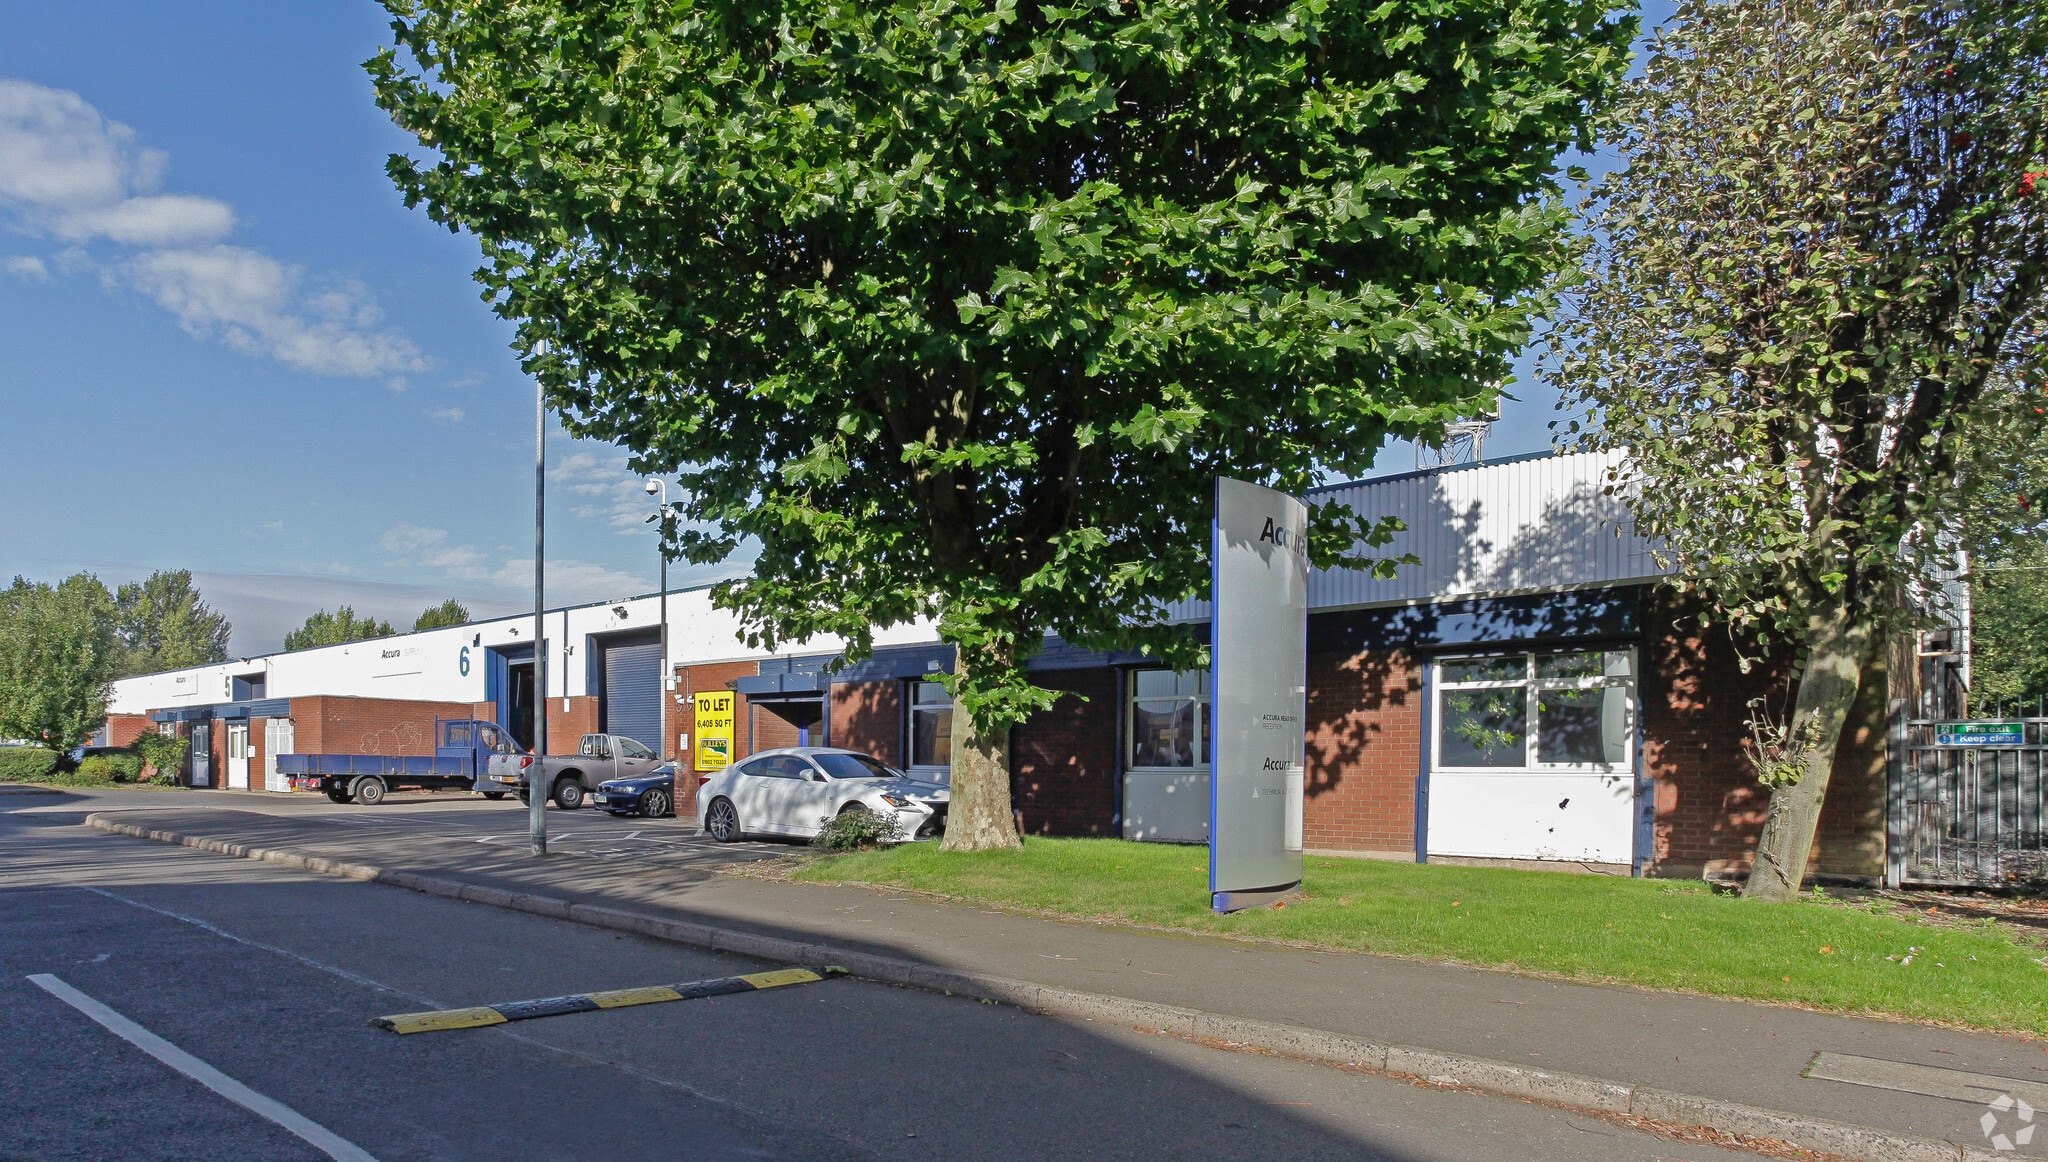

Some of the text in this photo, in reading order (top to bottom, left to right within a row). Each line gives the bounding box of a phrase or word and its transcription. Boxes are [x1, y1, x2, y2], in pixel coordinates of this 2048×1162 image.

[1260, 517, 1305, 556] Accura
[381, 649, 400, 659] Accura
[460, 646, 469, 676] 6
[225, 676, 230, 697] 5
[699, 698, 730, 711] TO LET
[698, 720, 713, 728] 6,405
[725, 719, 731, 727] FT
[1989, 725, 2010, 733] exit
[1960, 734, 2016, 743] Keep clear
[1263, 757, 1290, 770] Accura
